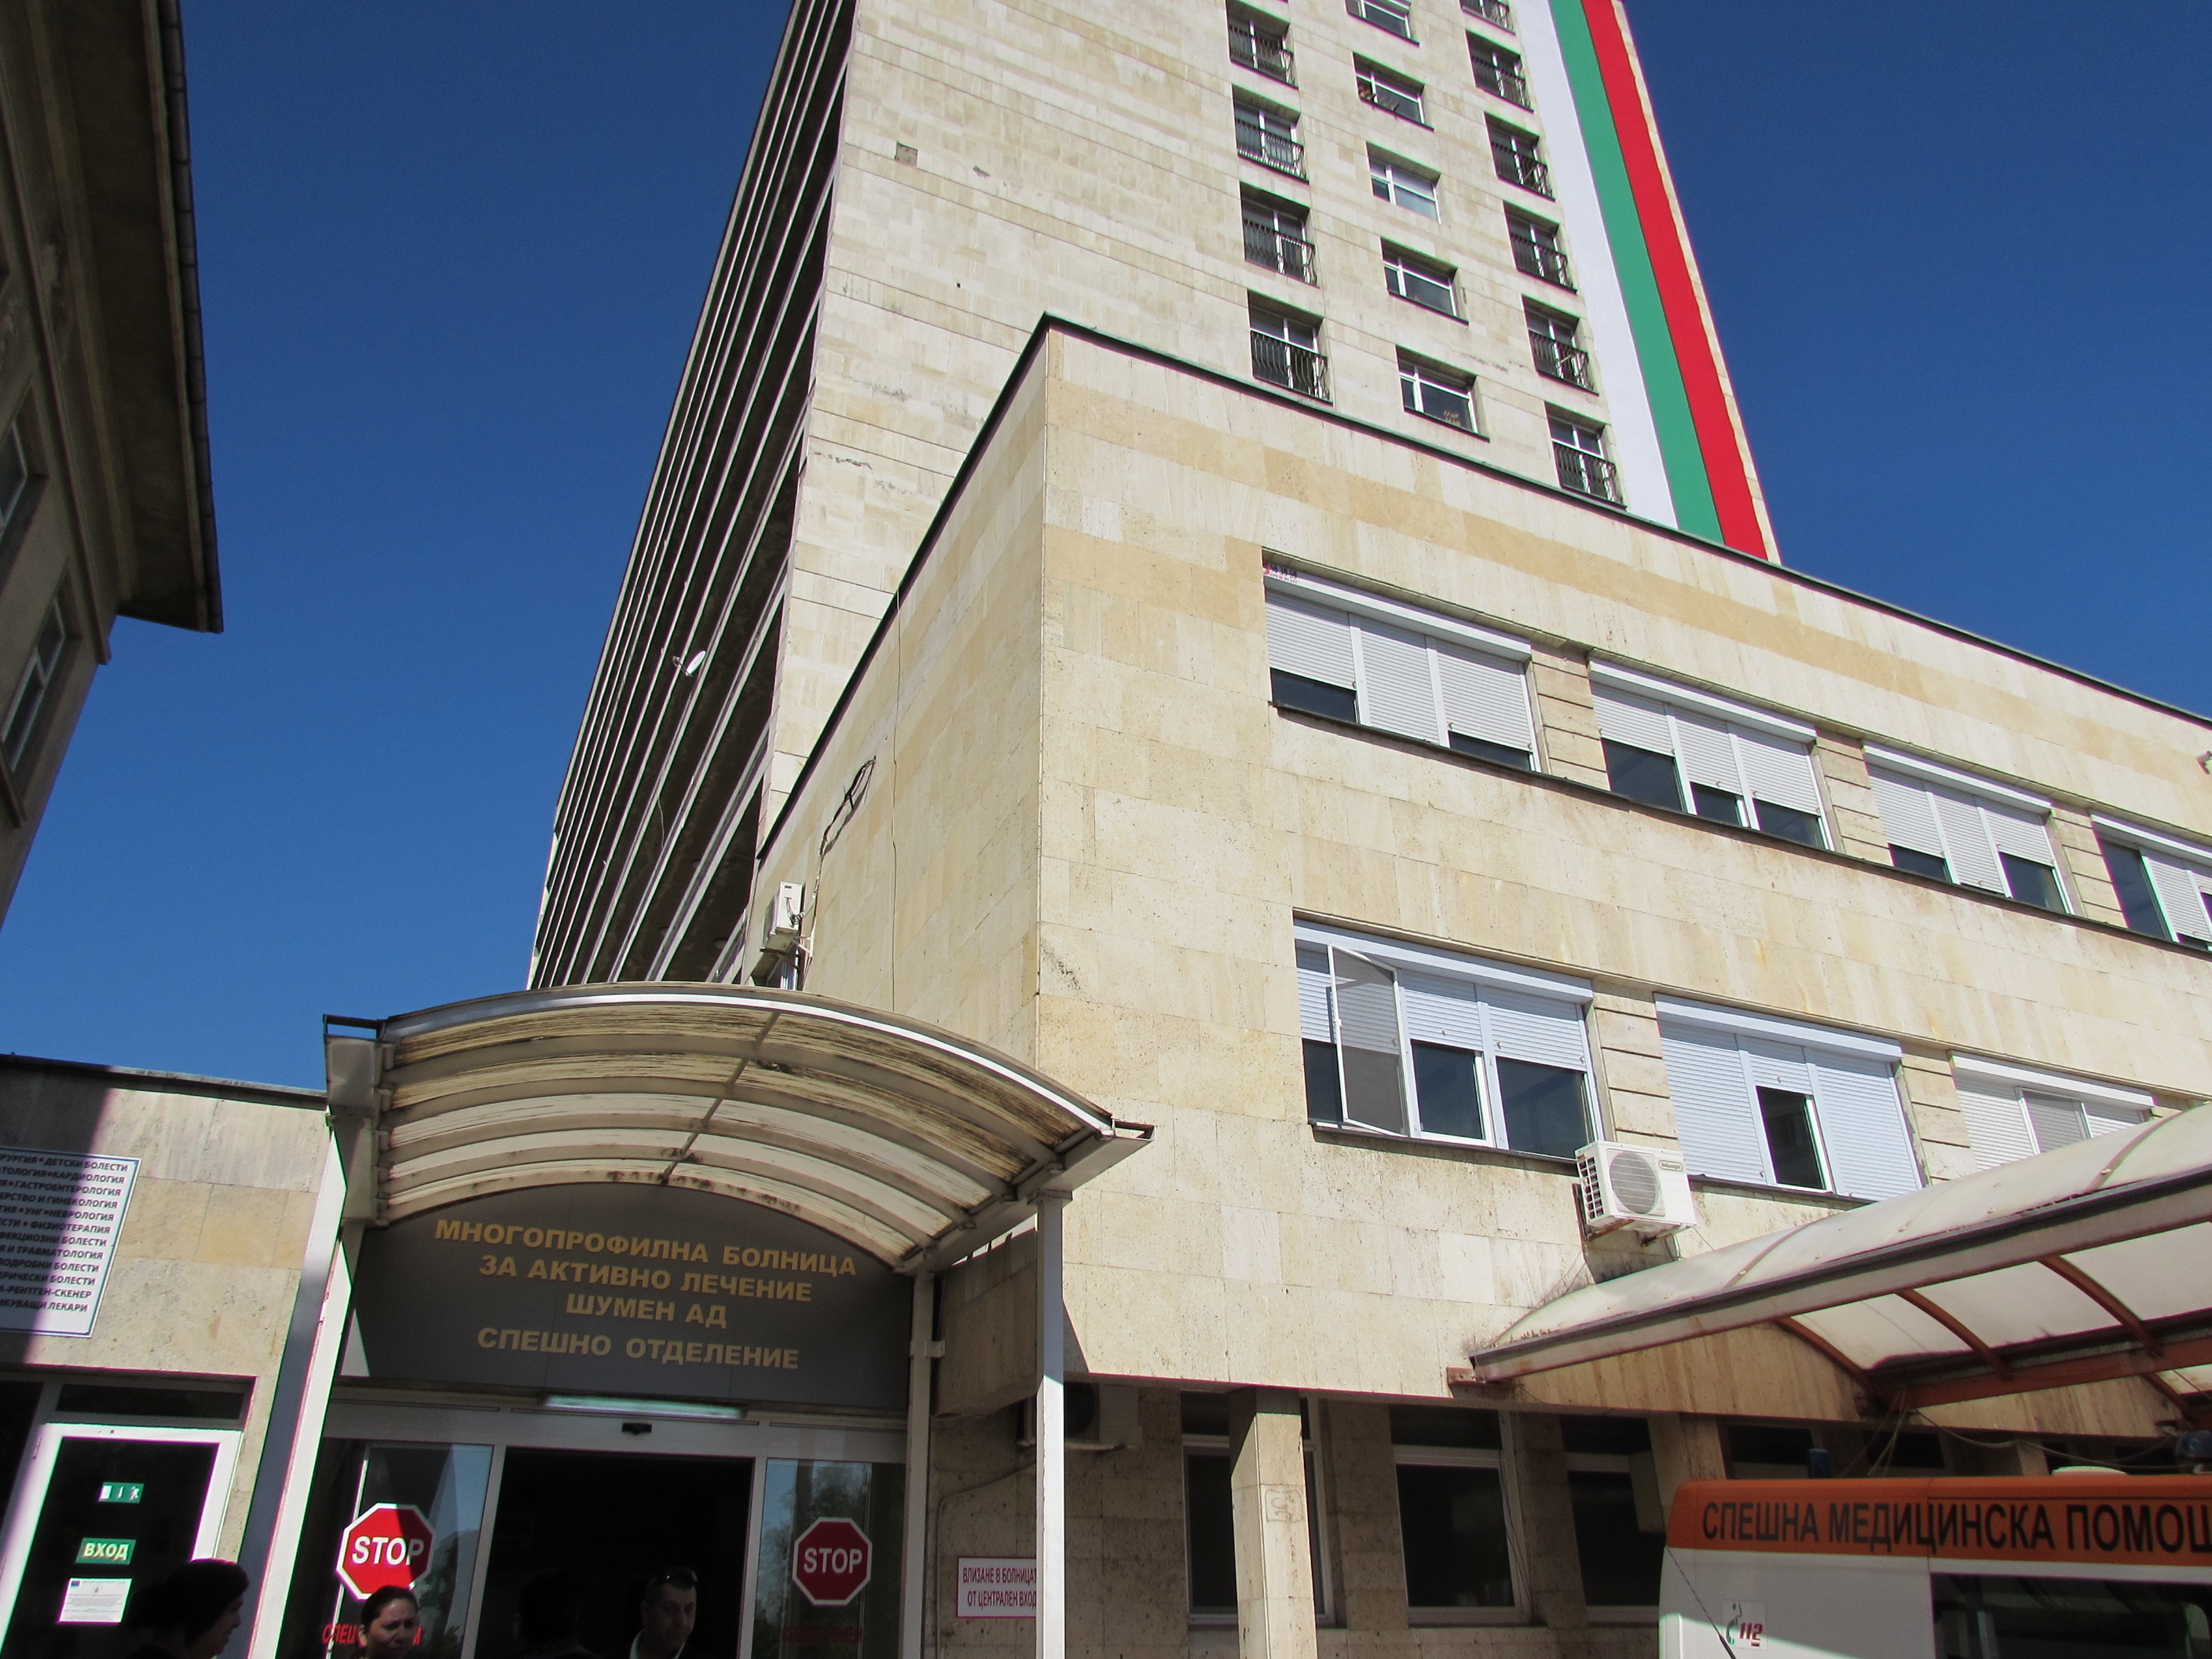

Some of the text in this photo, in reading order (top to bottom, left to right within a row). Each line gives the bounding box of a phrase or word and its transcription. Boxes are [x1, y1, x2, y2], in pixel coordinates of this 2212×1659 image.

[44, 1158, 82, 1168] ДЕТСКИ
[84, 1161, 128, 1171] БОЛЕСТИ
[53, 1171, 125, 1184] КАРДИОЛОГИЯ
[14, 1181, 122, 1196] ГАСТРОЕНТЕРОЛОГИЯ
[46, 1196, 118, 1209] ГИНЕКОЛОГИЯ
[24, 1207, 43, 1215] УНГ
[49, 1210, 114, 1221] НЕВРОЛОГИЯ
[0, 1218, 111, 1234] СТИ ФИЗИОТЕРАПИЯ
[61, 1236, 107, 1247] БОЛЕСТИ
[434, 1218, 857, 1276] МНОГОПРОФИЛНА БОЛНИЦА
[16, 1246, 103, 1259] ТРАВМАТОЛОГИЯ
[53, 1262, 100, 1273] БОЛЕСТИ
[50, 1275, 96, 1285] БОЛЕСТИ
[479, 1254, 812, 1302] ЗА АКТИВНО ЛЕЧЕНИЕ
[47, 1302, 88, 1313] ЛЕКАРИ
[566, 1294, 727, 1328] ШУМЕН АД
[477, 1327, 799, 1368] СПЕШНО ОТДЕЛЕНИЕ
[1702, 1501, 1818, 1543] СПЕШНА
[1829, 1503, 2055, 1553] МЕДИЦИНСКА
[83, 1542, 130, 1561] ВХОД
[352, 1536, 424, 1566] STOP
[803, 1547, 862, 1573] STOP
[963, 1567, 994, 1583] ВЛИЗАНЕ
[996, 1568, 1001, 1583] В
[967, 1591, 976, 1606] ОТ
[978, 1591, 1018, 1610] ЦЕНТРАЛЕН
[1739, 1622, 1763, 1641] 112
